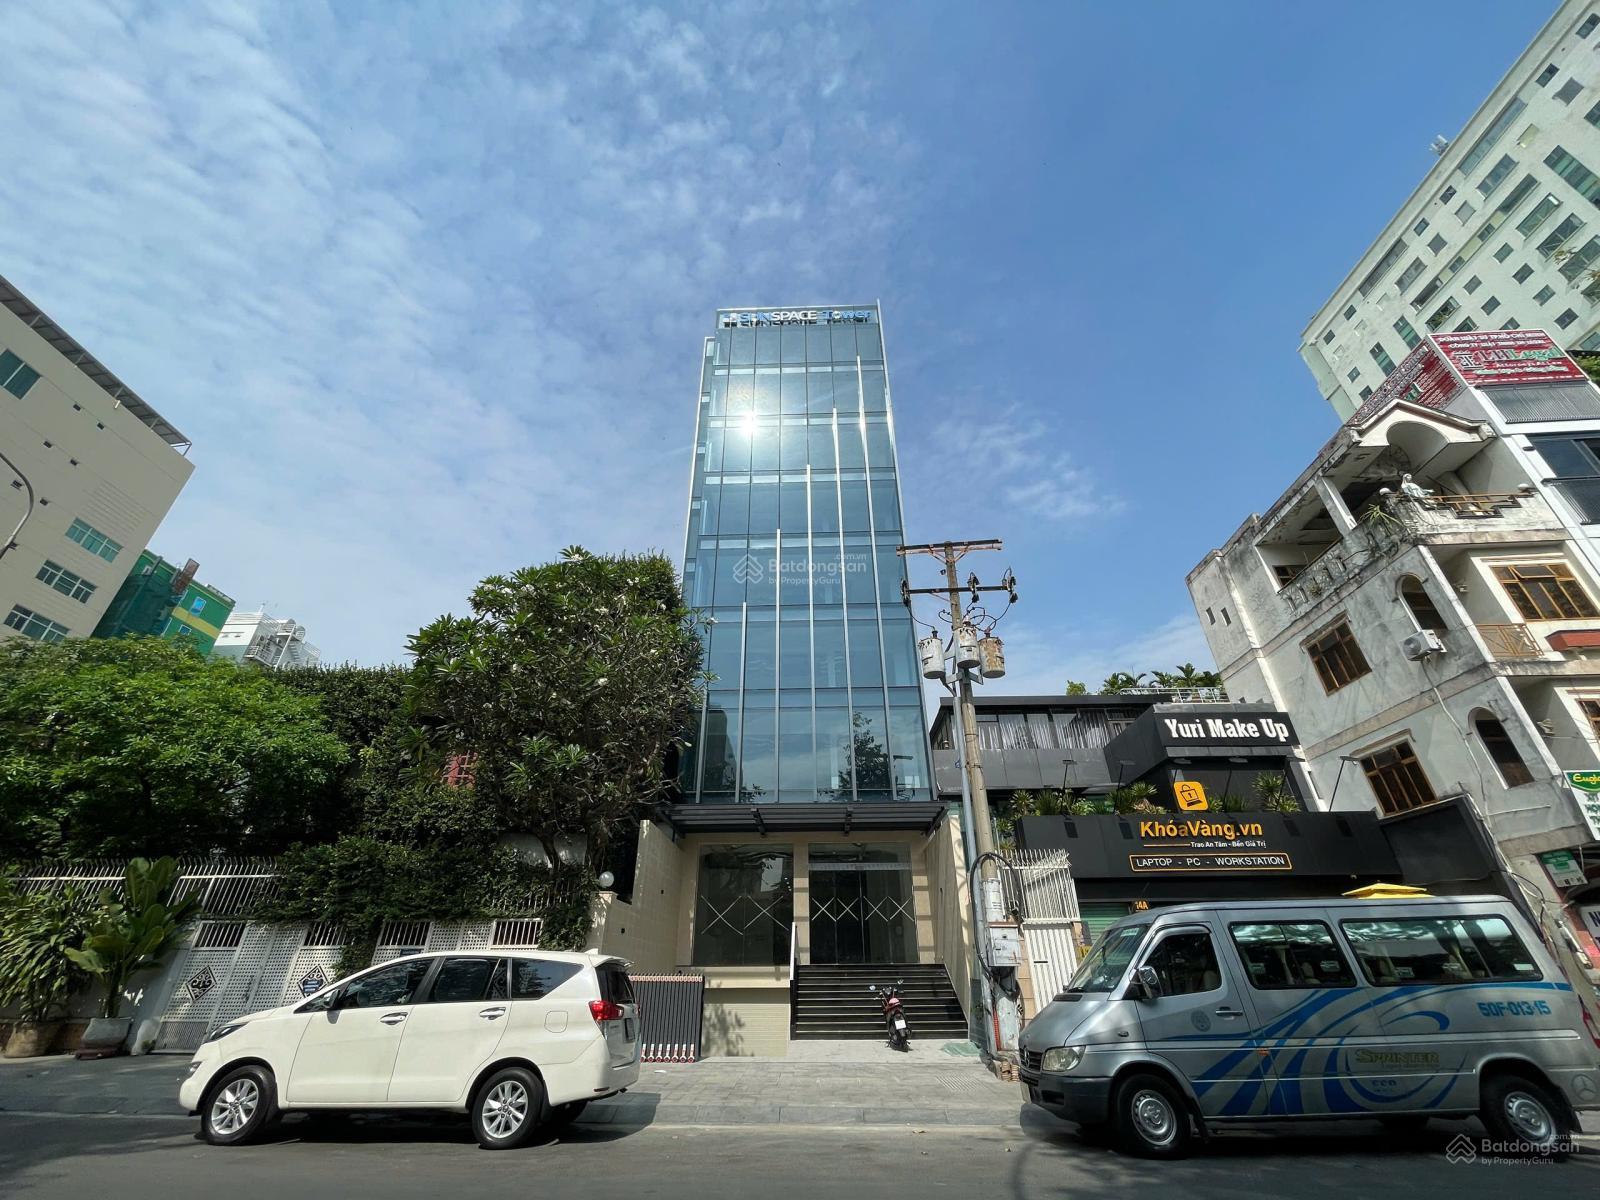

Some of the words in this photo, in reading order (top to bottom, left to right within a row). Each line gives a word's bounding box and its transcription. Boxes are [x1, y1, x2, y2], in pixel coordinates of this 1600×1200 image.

[1165, 718, 1206, 738] Yuri
[1207, 718, 1260, 739] Make
[1260, 718, 1290, 742] Up
[1140, 819, 1263, 840] KhóaVàng.vn
[1136, 858, 1173, 868] LAPTOP
[1187, 858, 1201, 867] PC
[1215, 856, 1285, 866] WORKSTATION
